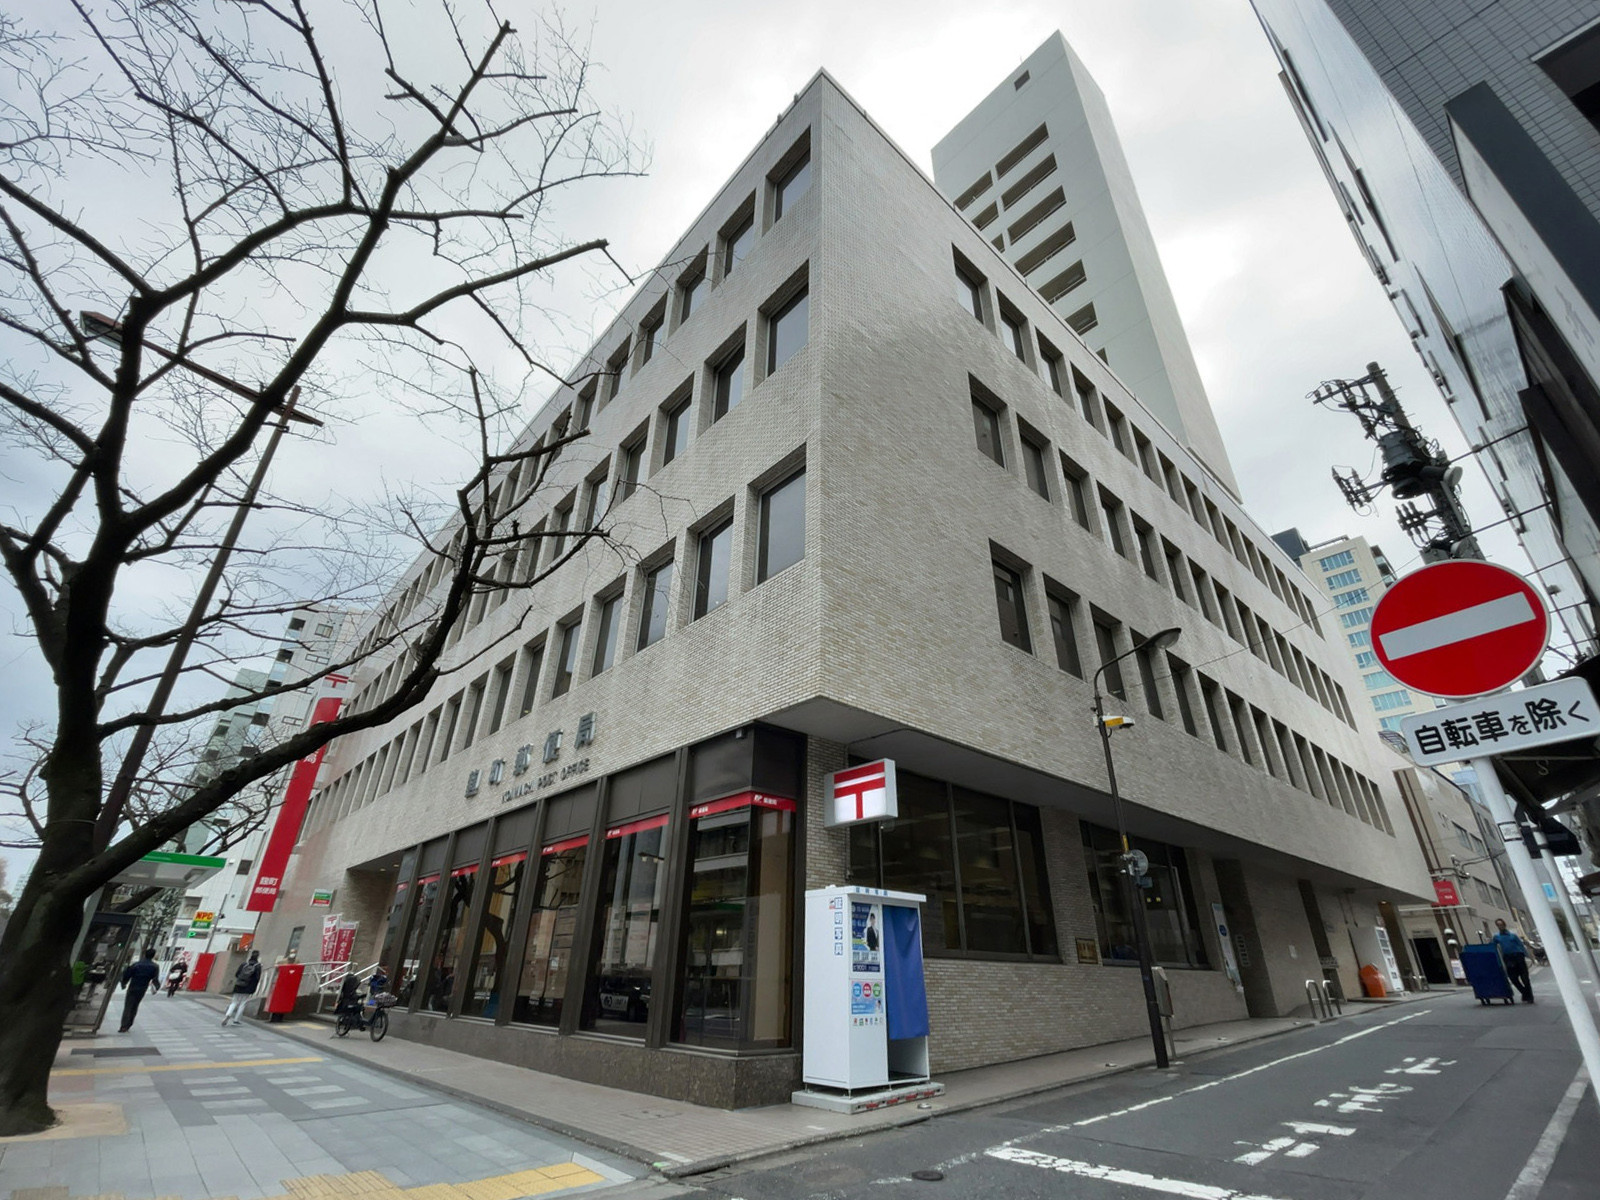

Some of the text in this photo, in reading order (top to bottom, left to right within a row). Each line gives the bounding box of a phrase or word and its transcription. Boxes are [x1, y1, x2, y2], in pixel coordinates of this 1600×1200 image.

[1414, 698, 1590, 755] 自転車を除く
[196, 911, 214, 920] NPC
